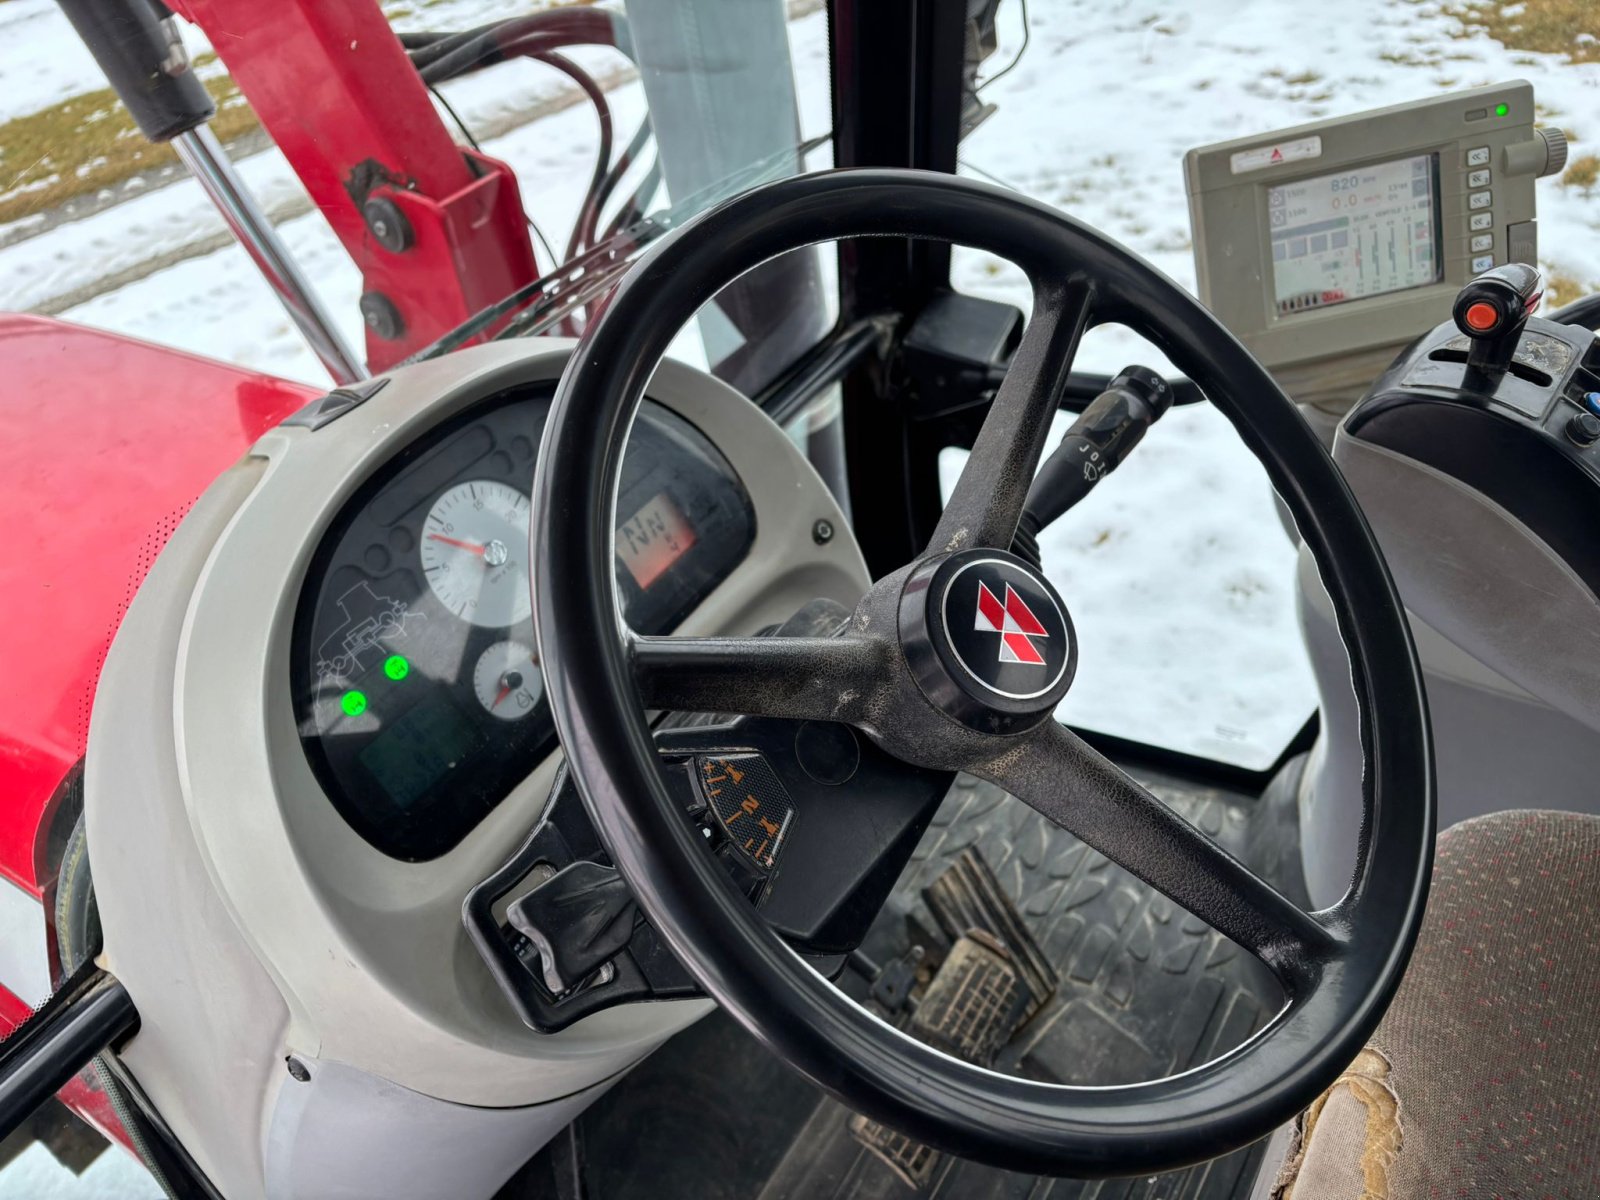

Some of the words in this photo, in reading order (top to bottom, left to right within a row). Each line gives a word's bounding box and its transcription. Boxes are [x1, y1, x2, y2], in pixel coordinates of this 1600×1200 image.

[1331, 175, 1359, 192] 820
[1332, 193, 1358, 210] 0.0
[472, 500, 485, 513] 15
[504, 509, 519, 524] 20
[442, 522, 455, 536] 10
[441, 562, 450, 572] 5
[469, 600, 478, 608] 0
[740, 794, 760, 815] N
